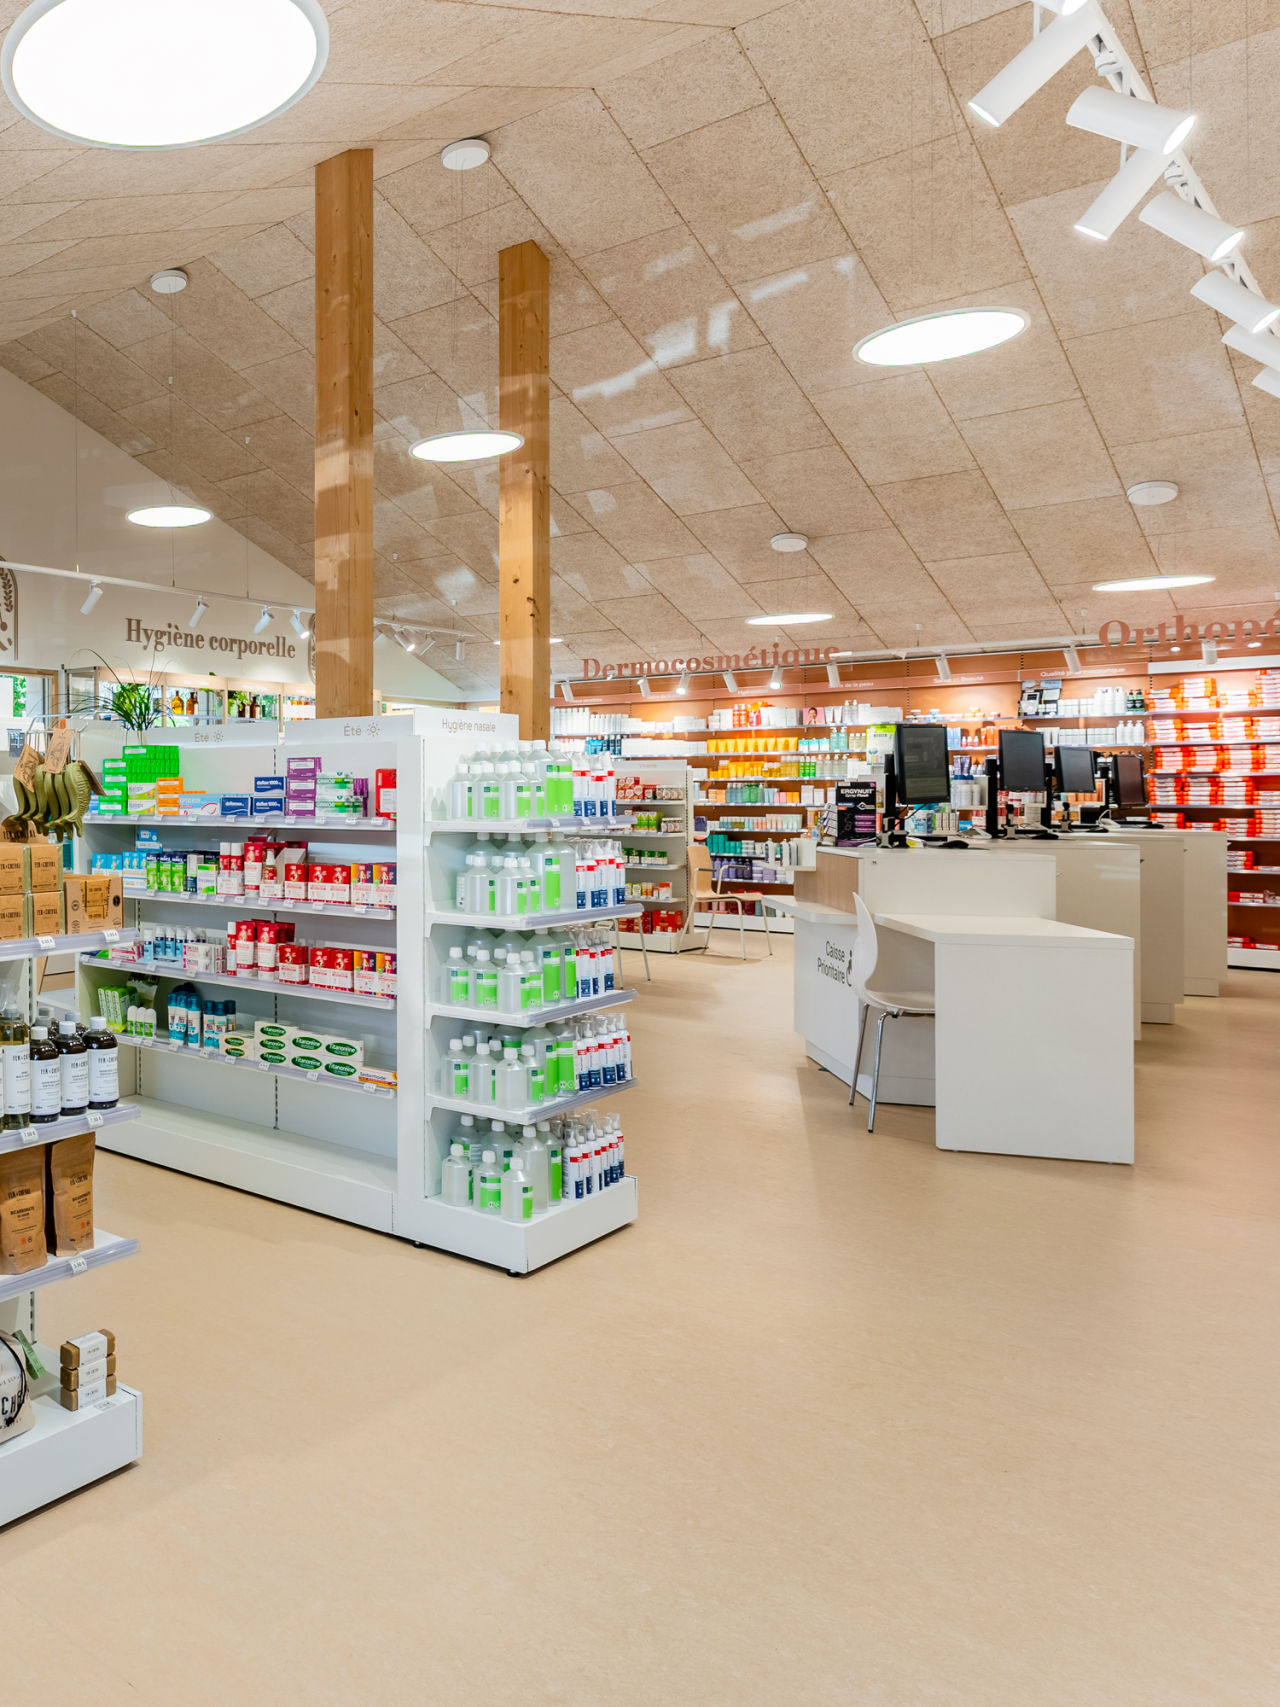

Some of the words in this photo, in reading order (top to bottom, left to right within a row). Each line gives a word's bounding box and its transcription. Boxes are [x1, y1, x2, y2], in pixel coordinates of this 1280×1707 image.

[1098, 608, 1280, 650] Orthopé
[125, 618, 204, 651] Hygiène
[209, 636, 295, 659] corporelle
[582, 642, 840, 679] Dermocosmétique
[1040, 669, 1065, 677] Qualité
[738, 688, 768, 696] Hydratation
[344, 724, 361, 736] Été
[442, 718, 472, 734] Hygiène
[474, 721, 496, 733] nasale
[194, 731, 209, 743] Été
[825, 940, 845, 963] Caisse
[817, 957, 845, 985] Prioritaire
[8, 1375, 20, 1384] DEPU
